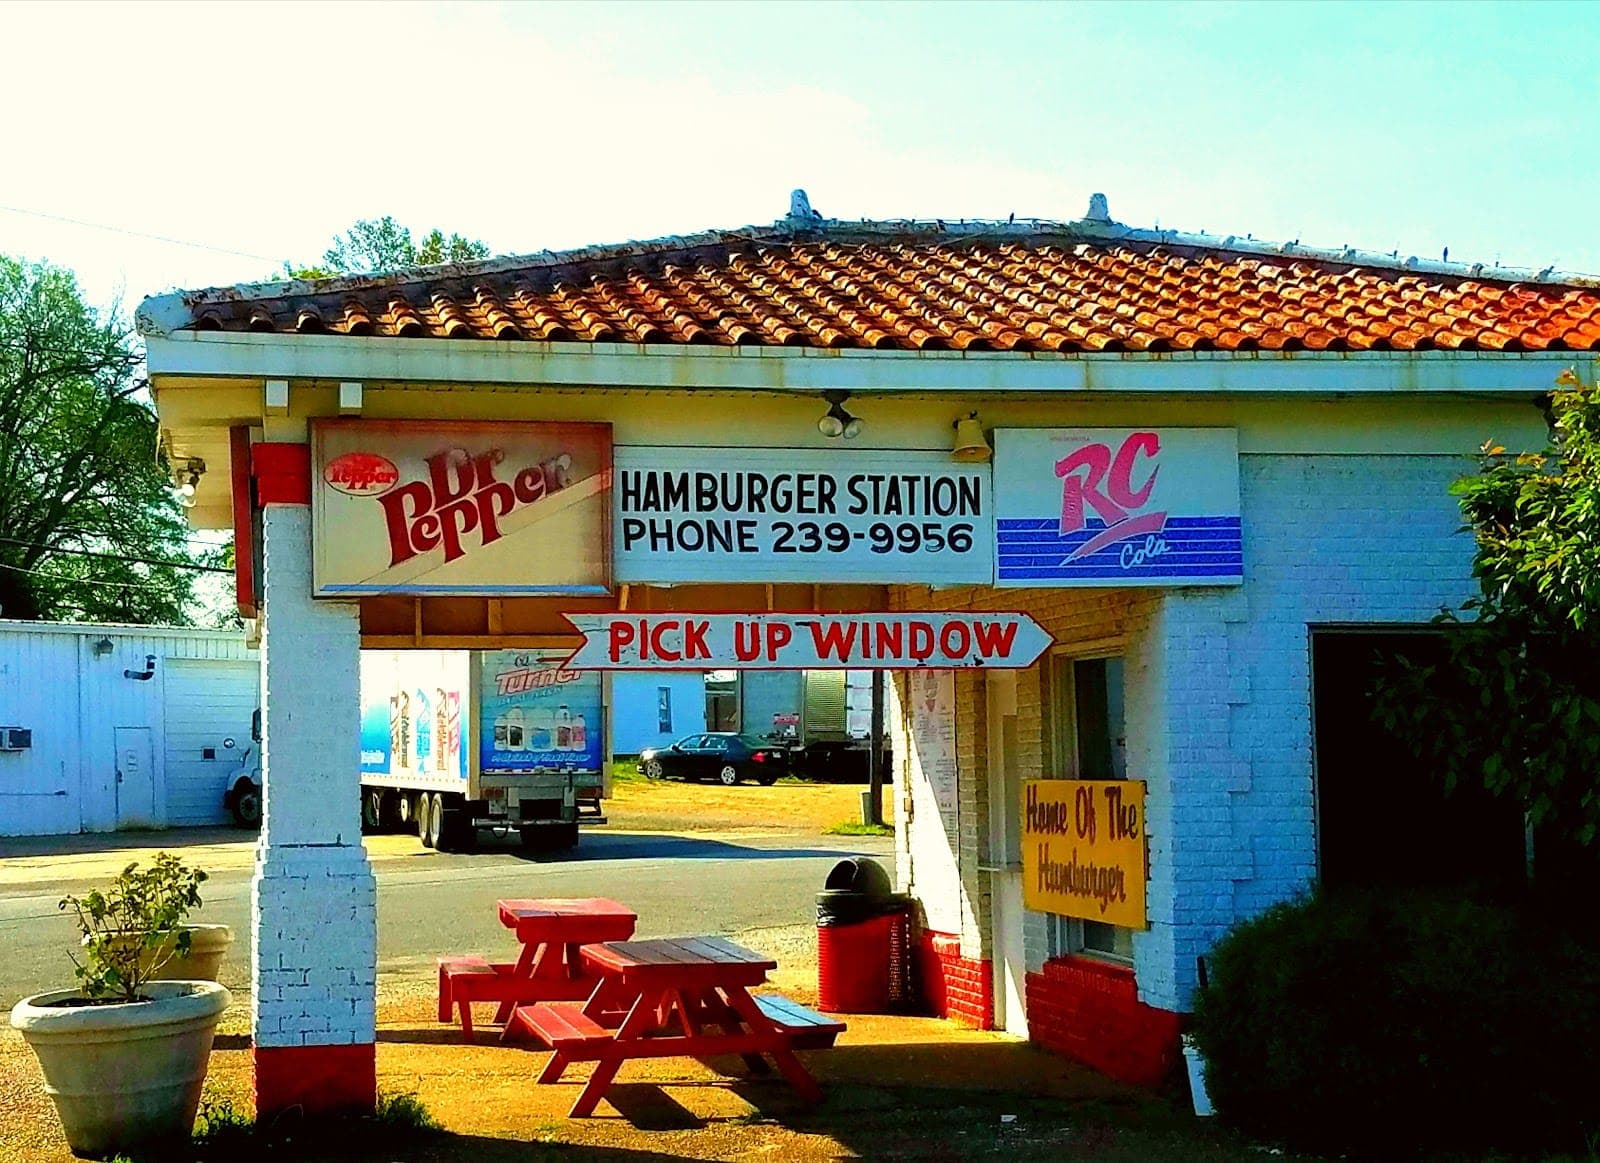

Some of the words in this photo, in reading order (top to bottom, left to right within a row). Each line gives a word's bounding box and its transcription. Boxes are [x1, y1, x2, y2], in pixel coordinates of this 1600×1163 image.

[425, 448, 504, 498] Dr
[620, 470, 838, 515] HAMBURGER
[847, 474, 982, 517] STATION
[1055, 432, 1162, 537] RC
[377, 454, 572, 568] Pepper
[622, 518, 760, 552] PHONE
[770, 521, 975, 554] 239-9956
[1119, 534, 1172, 570] Cola
[608, 619, 713, 662] PICK
[733, 620, 793, 662] UP
[811, 620, 1019, 662] WINDOW
[1026, 784, 1068, 836] Home
[1075, 785, 1097, 847] Of
[1104, 785, 1139, 842] The
[1037, 842, 1127, 915] Hamburger
